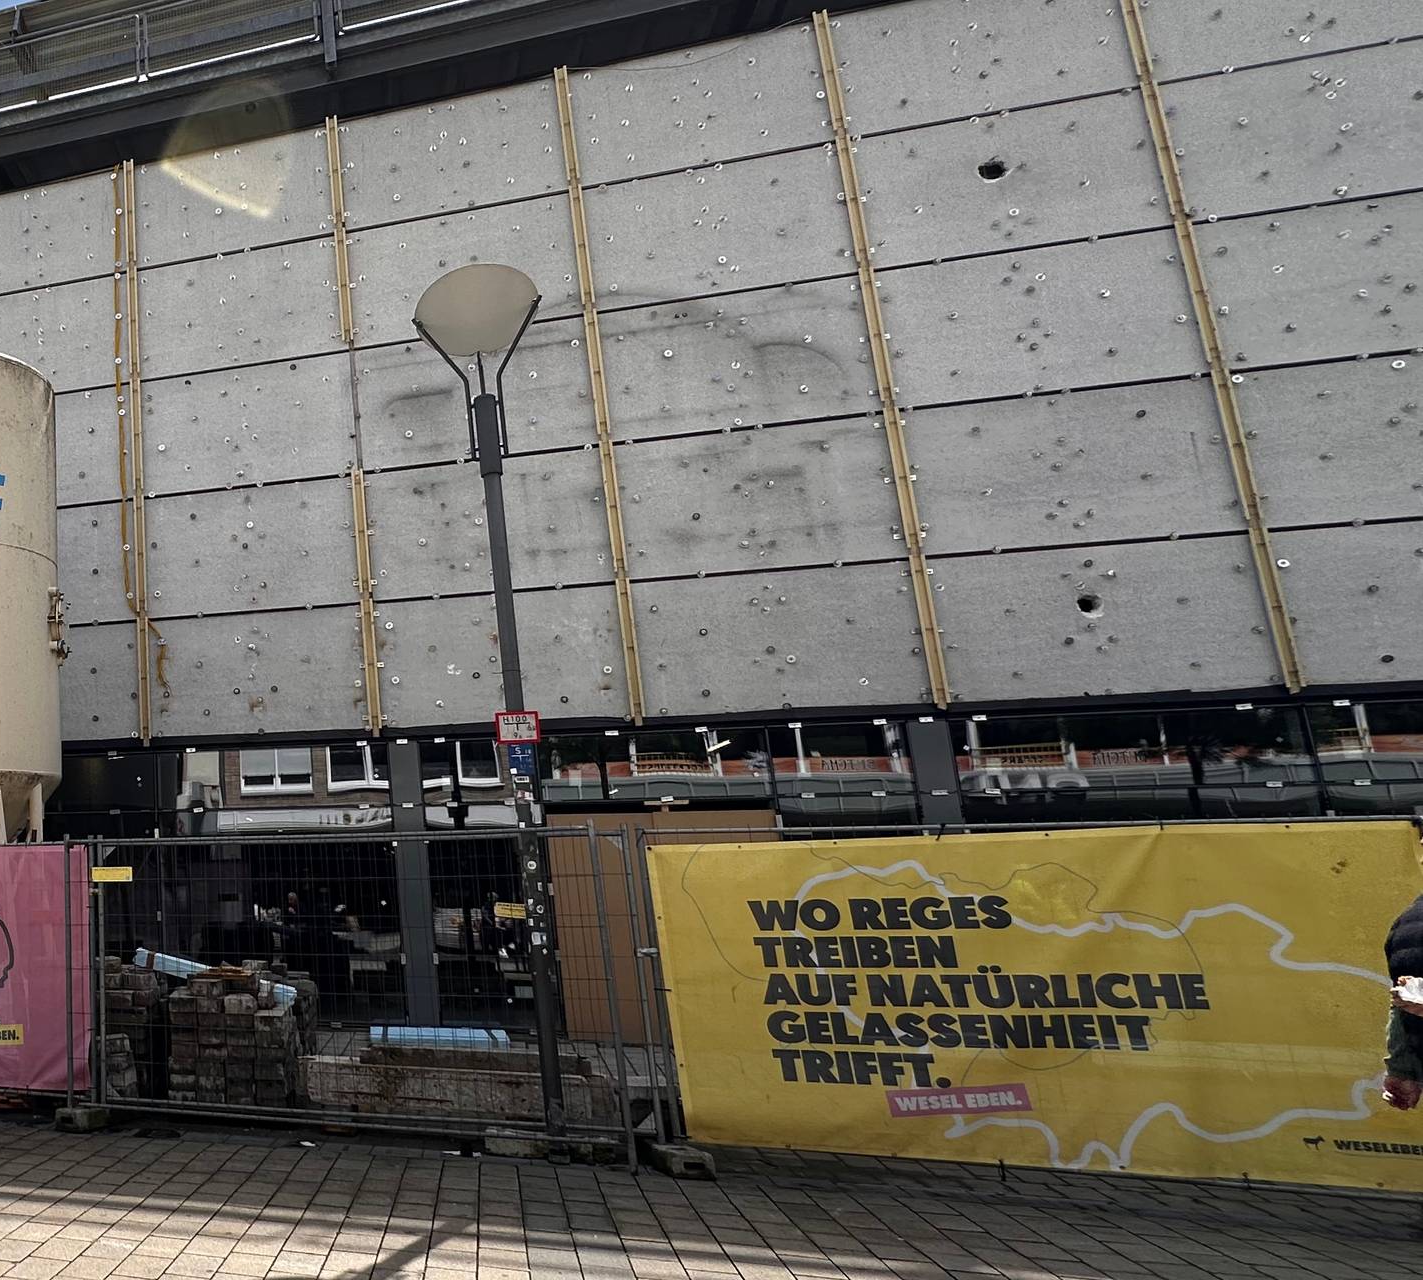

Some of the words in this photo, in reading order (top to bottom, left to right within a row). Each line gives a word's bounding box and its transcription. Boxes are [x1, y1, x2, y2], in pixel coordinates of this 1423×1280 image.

[747, 899, 840, 931] WO
[848, 895, 1012, 930] REGES
[753, 935, 959, 969] TREIBEN
[764, 973, 857, 1006] AUF
[866, 965, 1210, 1010] NATÜRLICHE
[767, 1011, 1149, 1051] GELASSENHEIT
[772, 1048, 952, 1089] TRIFFT.
[895, 1093, 963, 1112] WESEL
[964, 1090, 1023, 1109] EBEN.
[1333, 1139, 1423, 1156] WESELEBE
